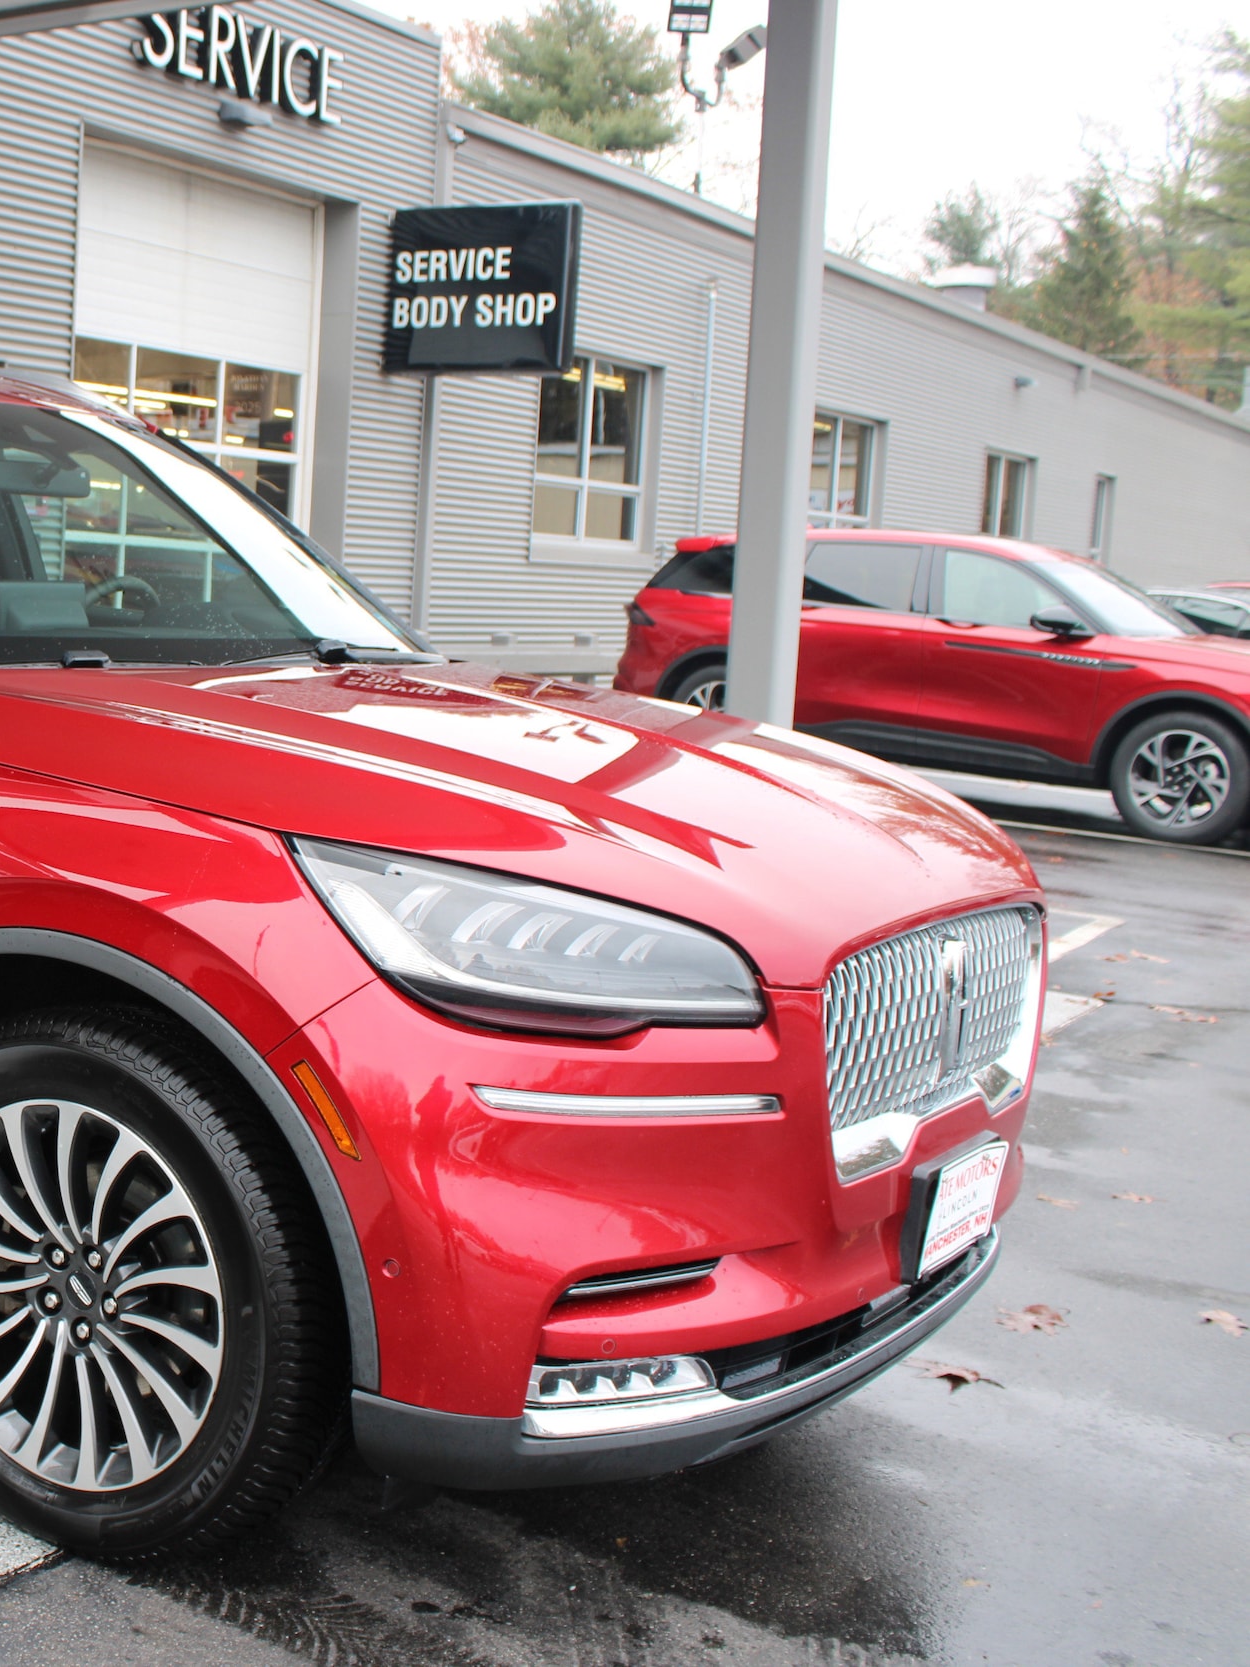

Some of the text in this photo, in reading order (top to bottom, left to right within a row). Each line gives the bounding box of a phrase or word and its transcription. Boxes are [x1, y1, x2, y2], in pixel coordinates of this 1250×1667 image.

[141, 5, 345, 125] SERVICE
[395, 246, 513, 284] SERVICE
[392, 292, 557, 329] BODY SHOP
[955, 1156, 999, 1190] MOTORS
[942, 1189, 979, 1219] LINCOLN
[974, 1211, 988, 1228] NH
